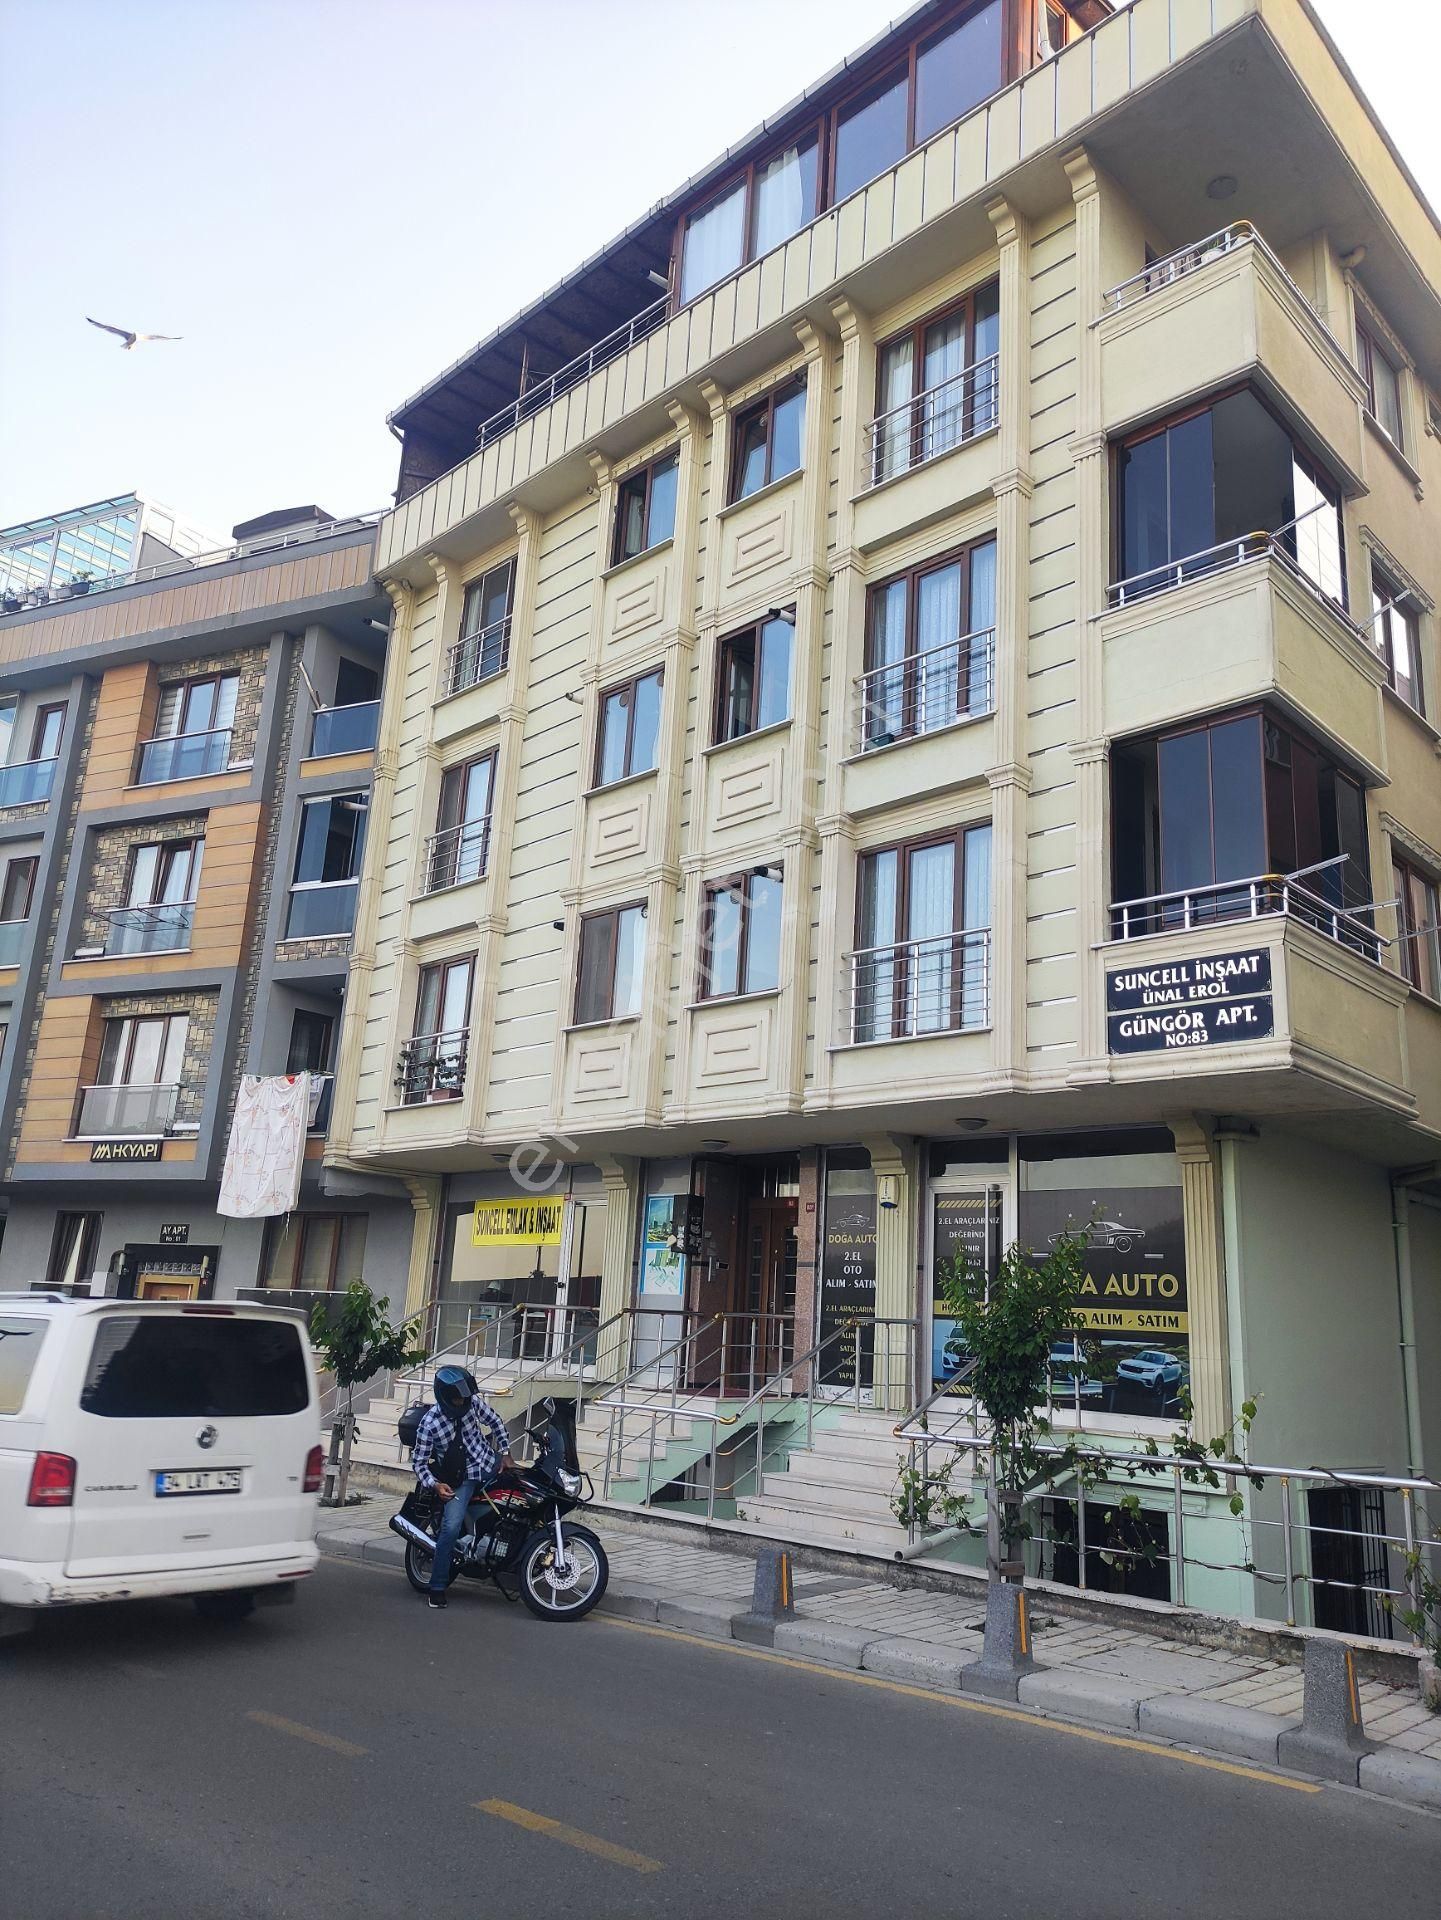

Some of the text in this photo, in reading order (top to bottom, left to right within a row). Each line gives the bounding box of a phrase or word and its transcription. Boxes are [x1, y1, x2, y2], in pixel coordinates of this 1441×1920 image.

[1114, 955, 1260, 991] SUNCELL İNŞAAT
[1142, 982, 1230, 1005] ÜNAL EROL
[1119, 1005, 1258, 1036] GÜNGÖR APT.
[1165, 1030, 1209, 1047] NO:83
[476, 1200, 562, 1241] SUNCELL EMLAK & İNŞAAT
[954, 1217, 1000, 1226] ARAÇLARNIZ
[161, 1226, 171, 1235] AY
[949, 1230, 985, 1238] DEĞERİND
[828, 1232, 853, 1243] DOĞA
[844, 1251, 862, 1261] 2.EL
[843, 1265, 862, 1275] OTO
[825, 1278, 846, 1288] ALIM
[1104, 1272, 1179, 1298] AUTO
[1090, 1313, 1123, 1326] ALIM
[1137, 1314, 1179, 1328] SATIM
